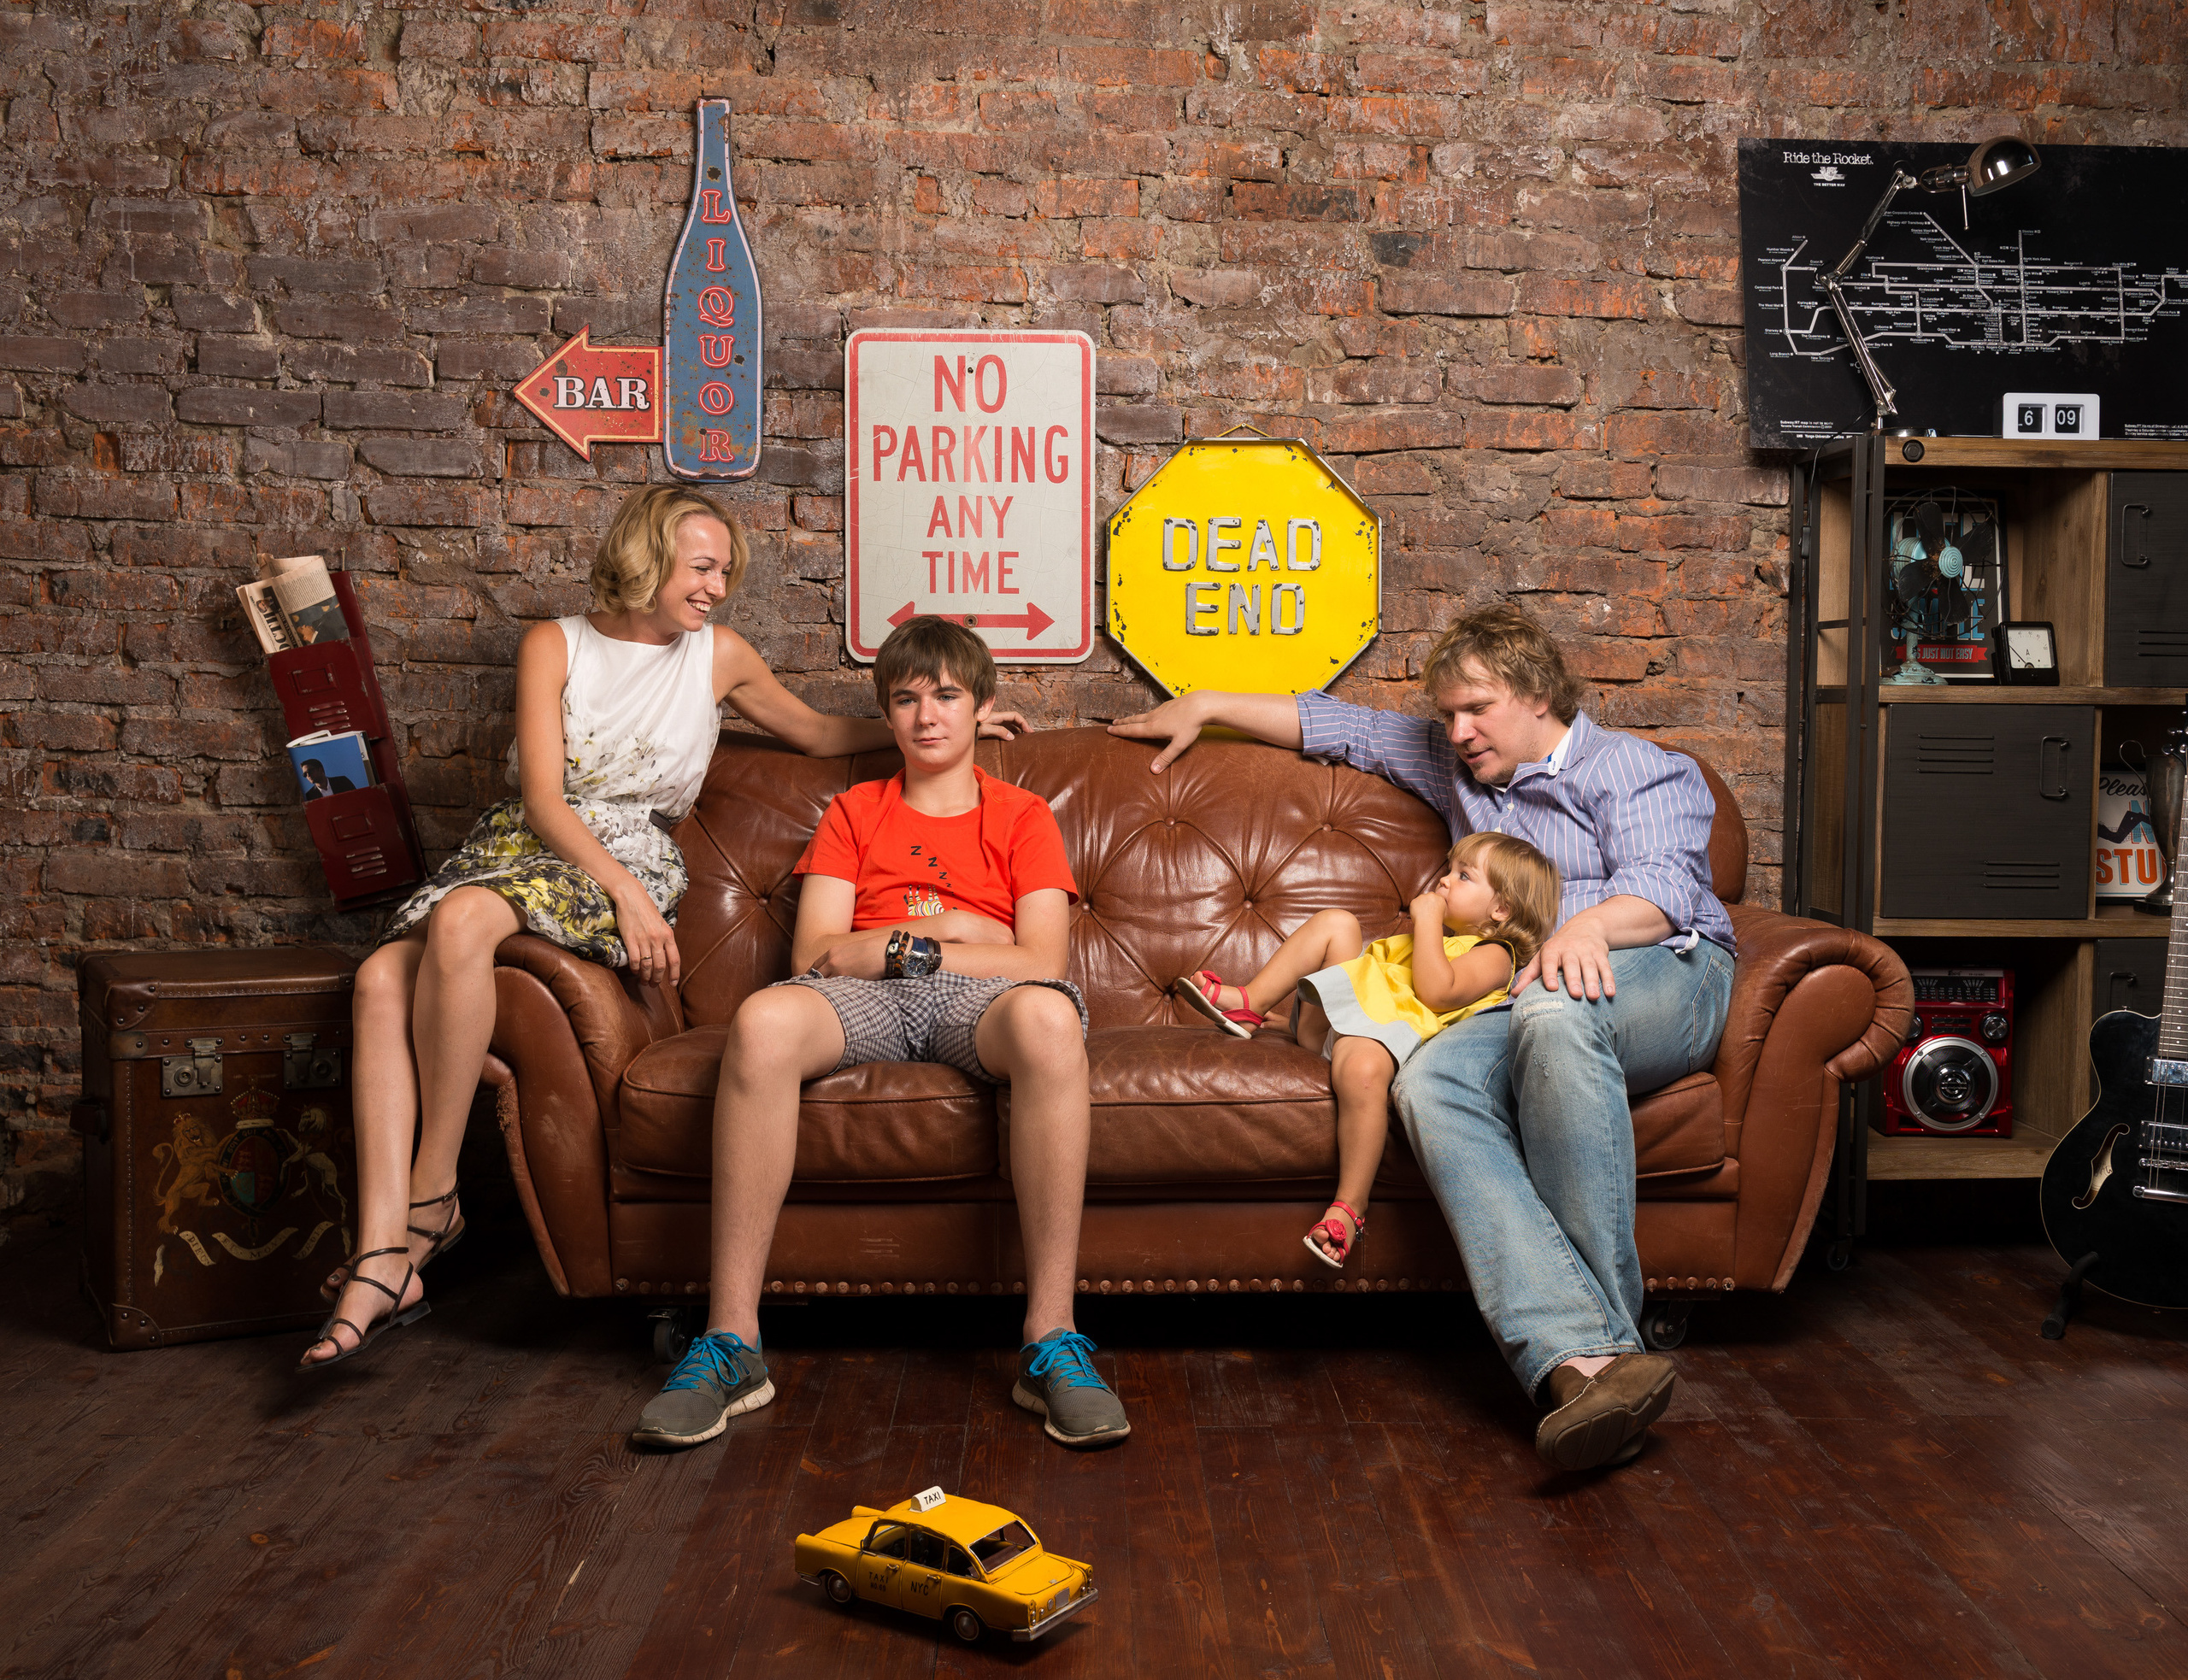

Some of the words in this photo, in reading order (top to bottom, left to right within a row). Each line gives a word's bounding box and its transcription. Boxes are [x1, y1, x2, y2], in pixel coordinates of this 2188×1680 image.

[1783, 152, 1810, 163] Ride
[1812, 152, 1831, 164] the
[1832, 153, 1873, 165] Rocket.
[698, 189, 735, 462] LIQUOR
[553, 375, 650, 409] BAR
[933, 354, 1008, 413] NO
[2024, 410, 2033, 426] 6
[2056, 410, 2076, 425] 09
[873, 425, 1068, 484] PARKING
[926, 496, 1013, 538] ANY
[1162, 517, 1322, 572] DEAD
[922, 551, 1020, 594] TIME
[1185, 582, 1304, 636] END
[1922, 647, 1938, 659] JUST
[1940, 647, 1954, 659] NOT
[1956, 648, 1973, 660] EASY
[2099, 777, 2147, 796] Pleas
[923, 1491, 941, 1505] TAXI
[868, 1571, 889, 1583] TAXI
[910, 1581, 929, 1595] NYC
